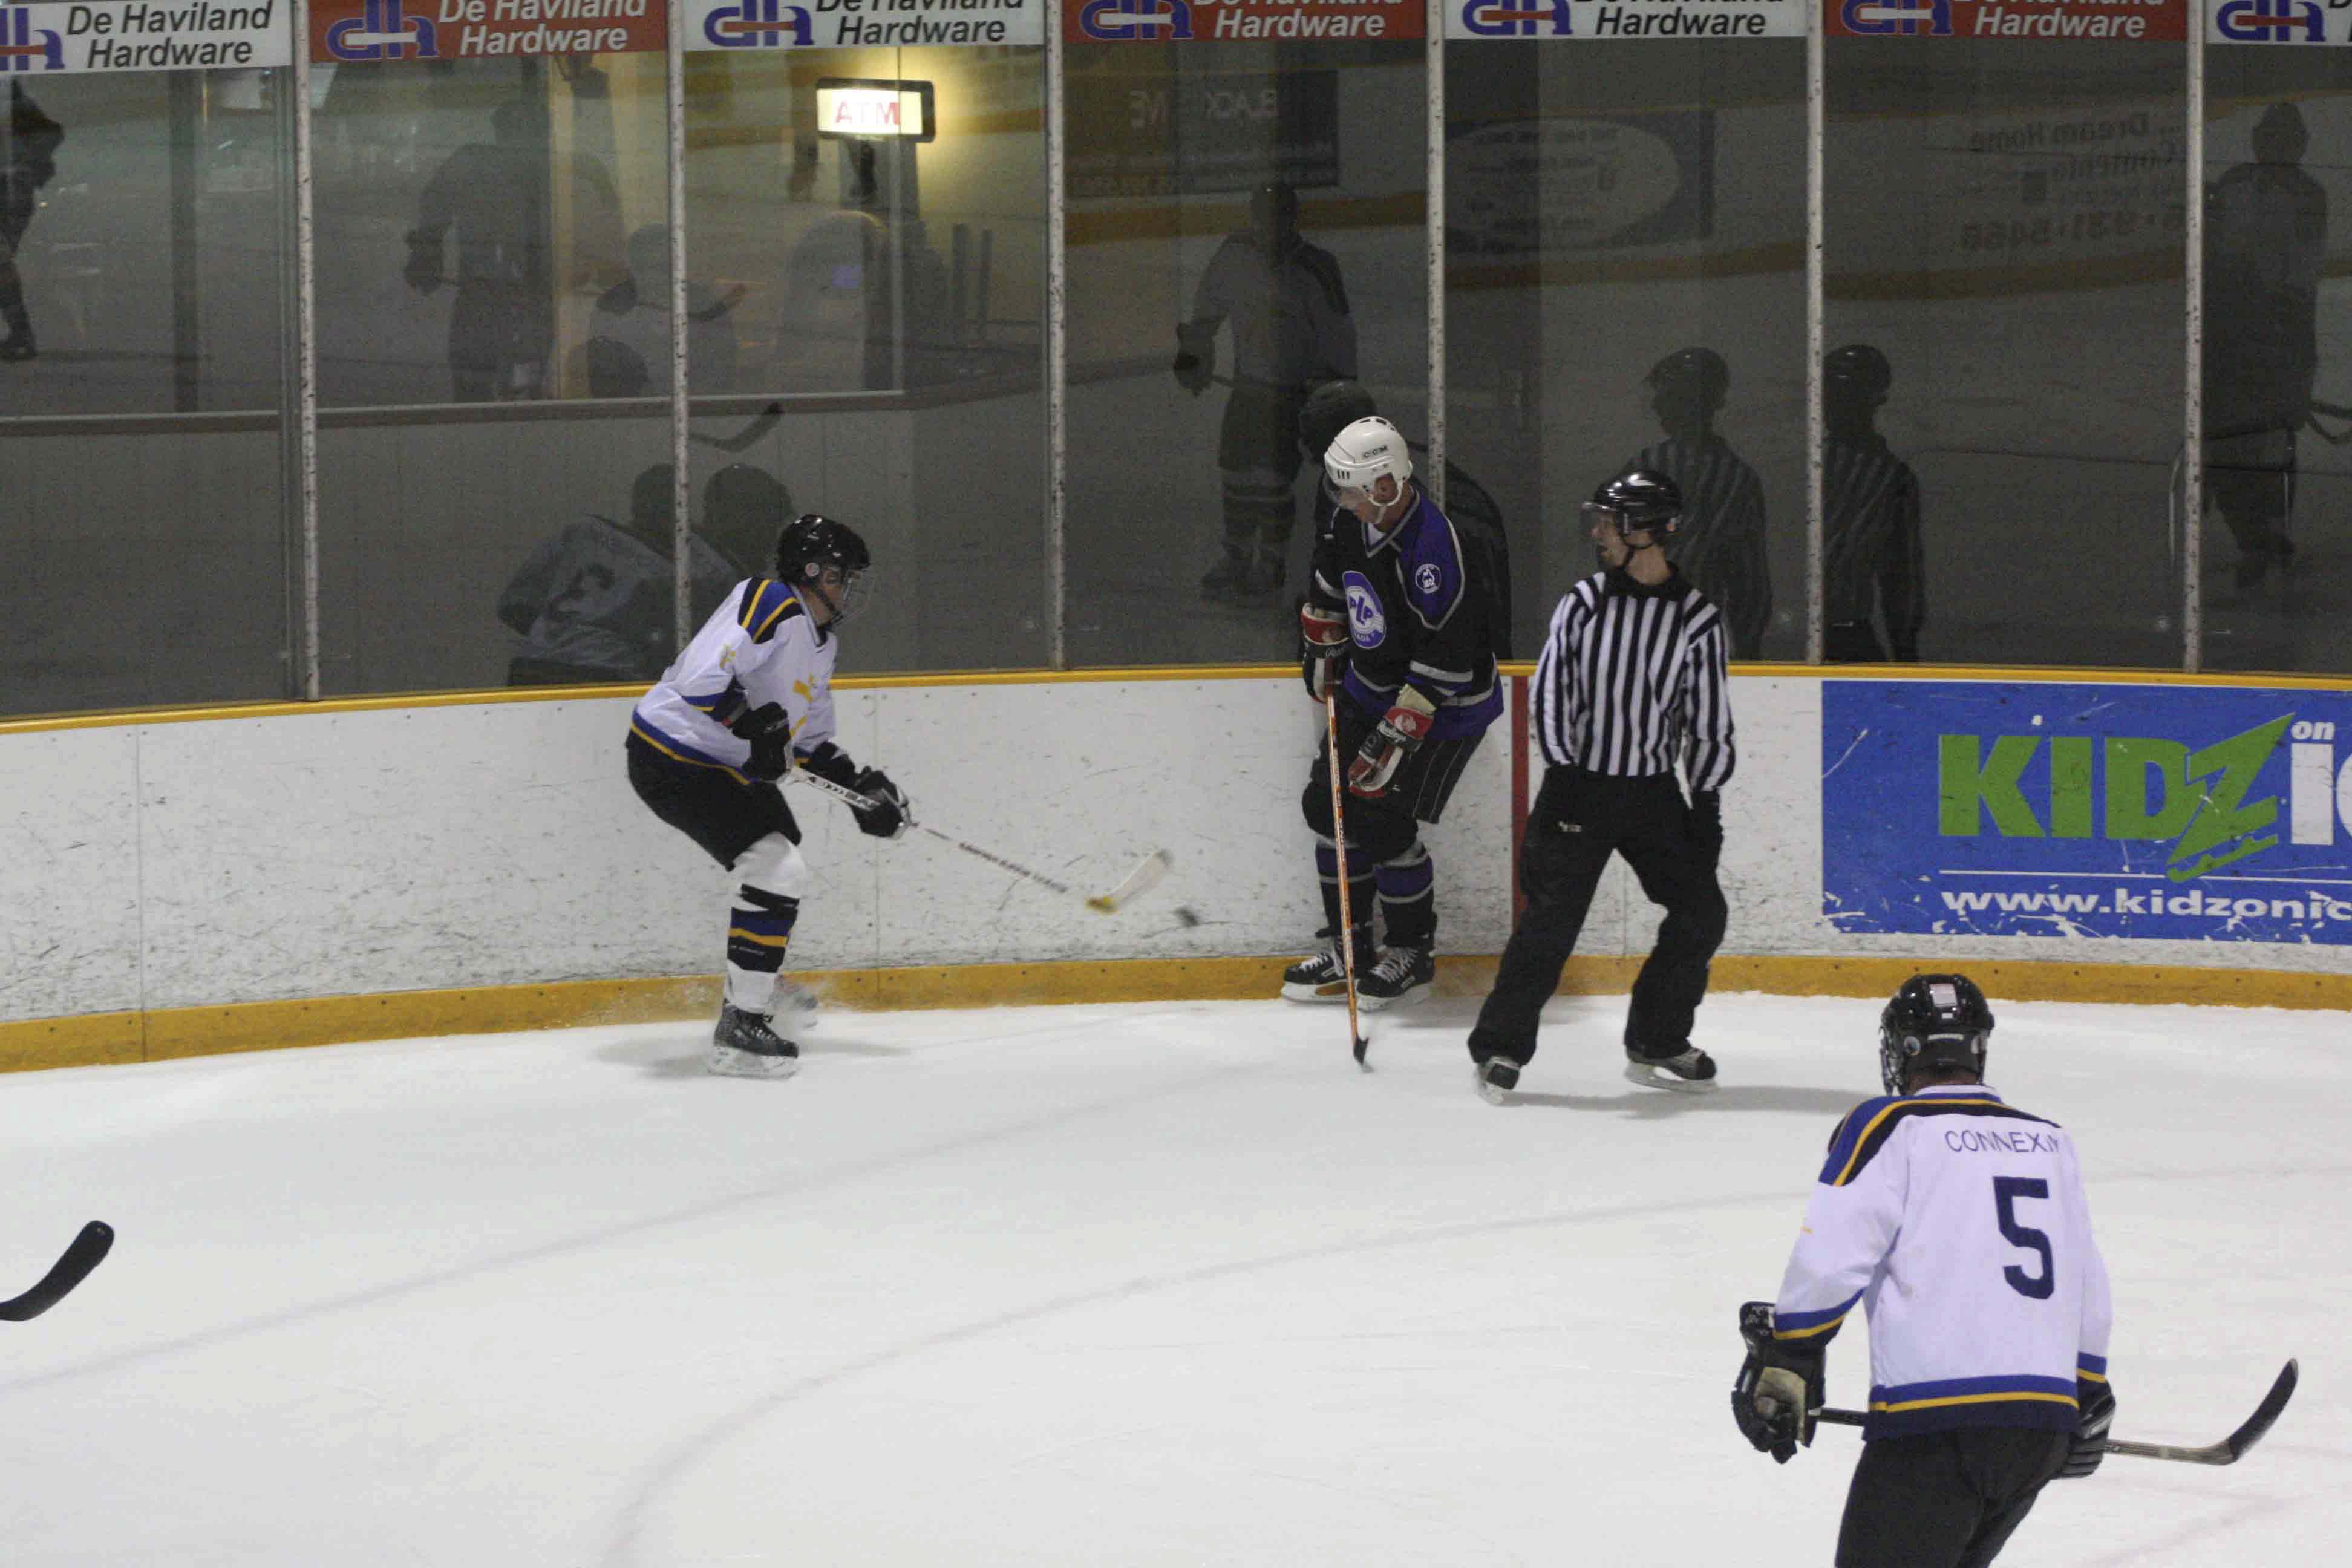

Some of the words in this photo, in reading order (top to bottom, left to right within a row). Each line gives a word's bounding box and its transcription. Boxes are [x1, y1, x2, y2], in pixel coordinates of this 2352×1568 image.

[67, 6, 113, 35] De
[121, 0, 273, 33] Haviland
[437, 0, 485, 24] De
[493, 0, 647, 22] Haviland
[1214, 8, 1386, 38] Hardware
[1595, 6, 1767, 36] Hardware
[1974, 5, 2146, 38] Hardware
[459, 23, 629, 56] Hardware
[837, 15, 1007, 45] Hardware
[87, 37, 252, 68] Hardware
[834, 100, 901, 125] ATM
[1939, 713, 2295, 866] KIDZ
[2290, 720, 2335, 741] on
[1992, 1175, 2055, 1300] 5
